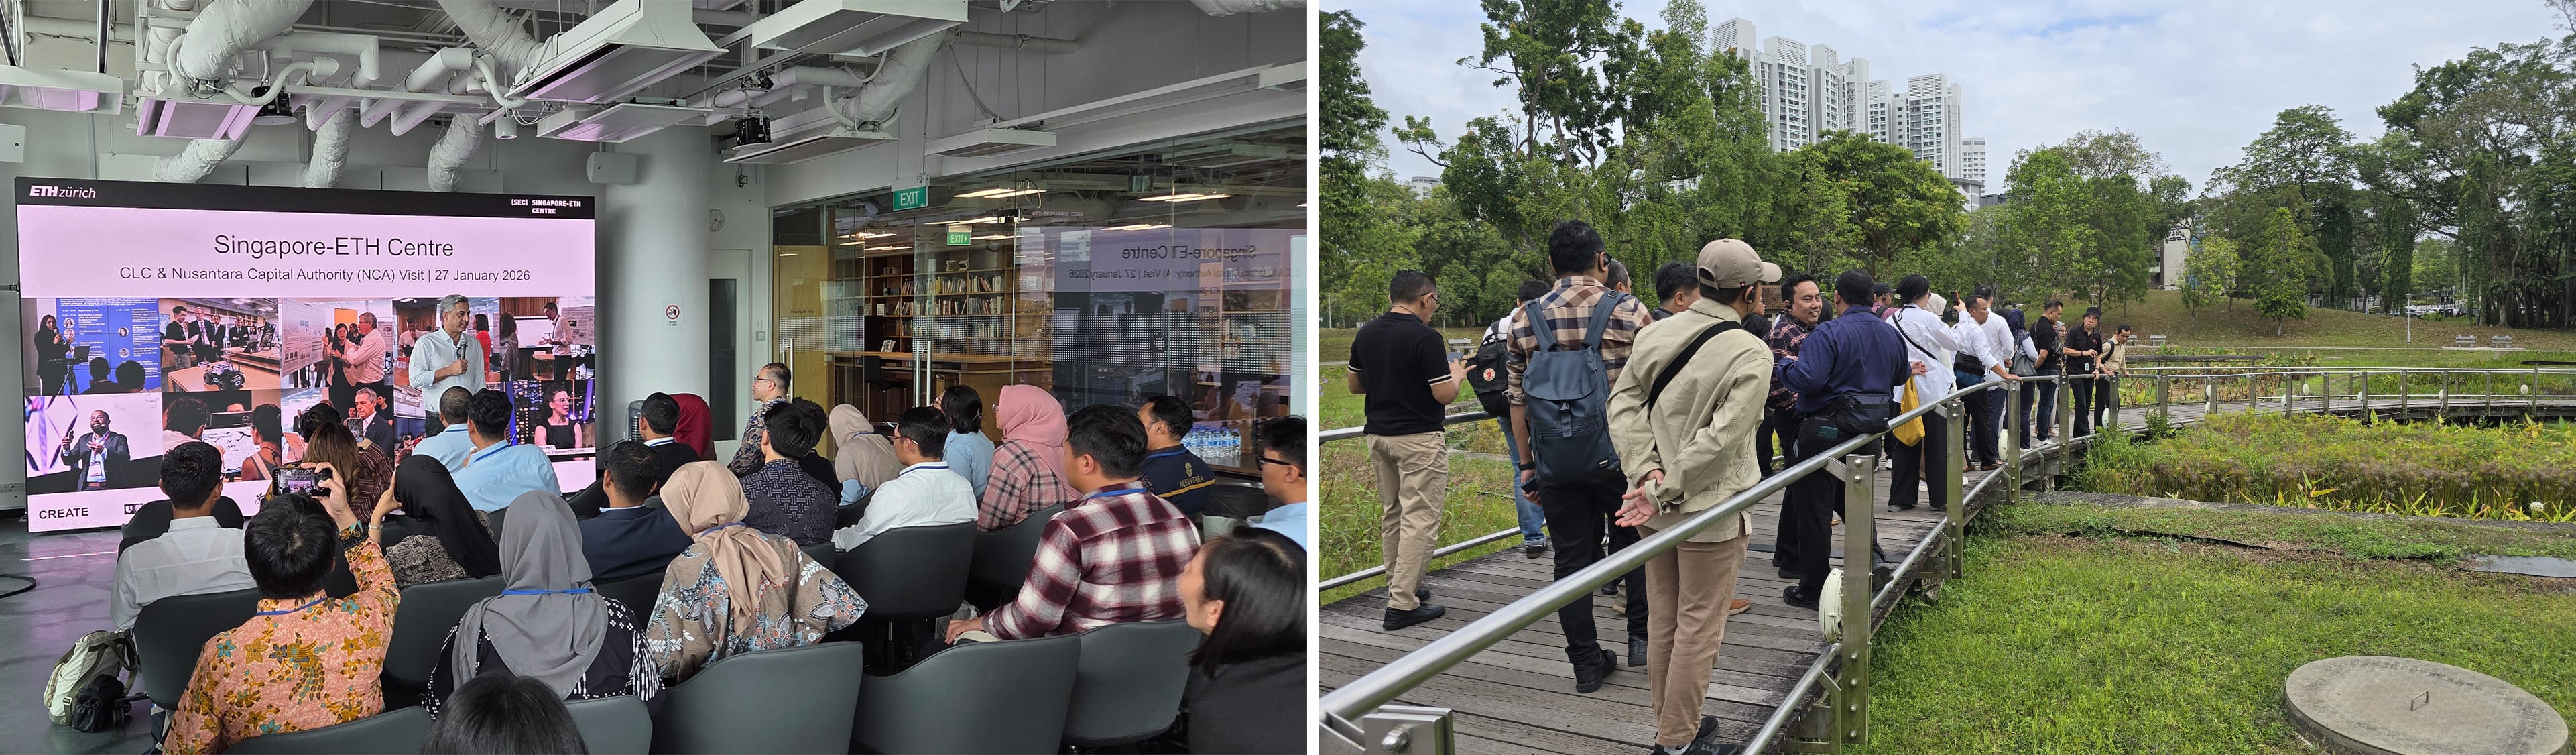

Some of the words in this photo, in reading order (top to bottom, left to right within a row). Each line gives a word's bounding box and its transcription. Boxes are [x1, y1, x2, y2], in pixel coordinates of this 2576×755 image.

[532, 199, 582, 207] SINGAPORE-ETH
[900, 191, 920, 206] EXIT
[950, 234, 964, 243] EXIT
[214, 235, 379, 259] Singapore-ETH
[387, 238, 454, 257] Centre
[120, 266, 152, 280] CLC
[157, 267, 168, 279] &
[172, 267, 243, 280] Nusantara
[247, 268, 293, 282] Capital
[297, 268, 353, 283] Authority
[357, 268, 395, 283] (NCA)
[399, 269, 424, 280] Visit
[434, 269, 449, 280] 27
[453, 270, 499, 284] January
[503, 270, 530, 281] 2026
[39, 507, 89, 520] CREATE
